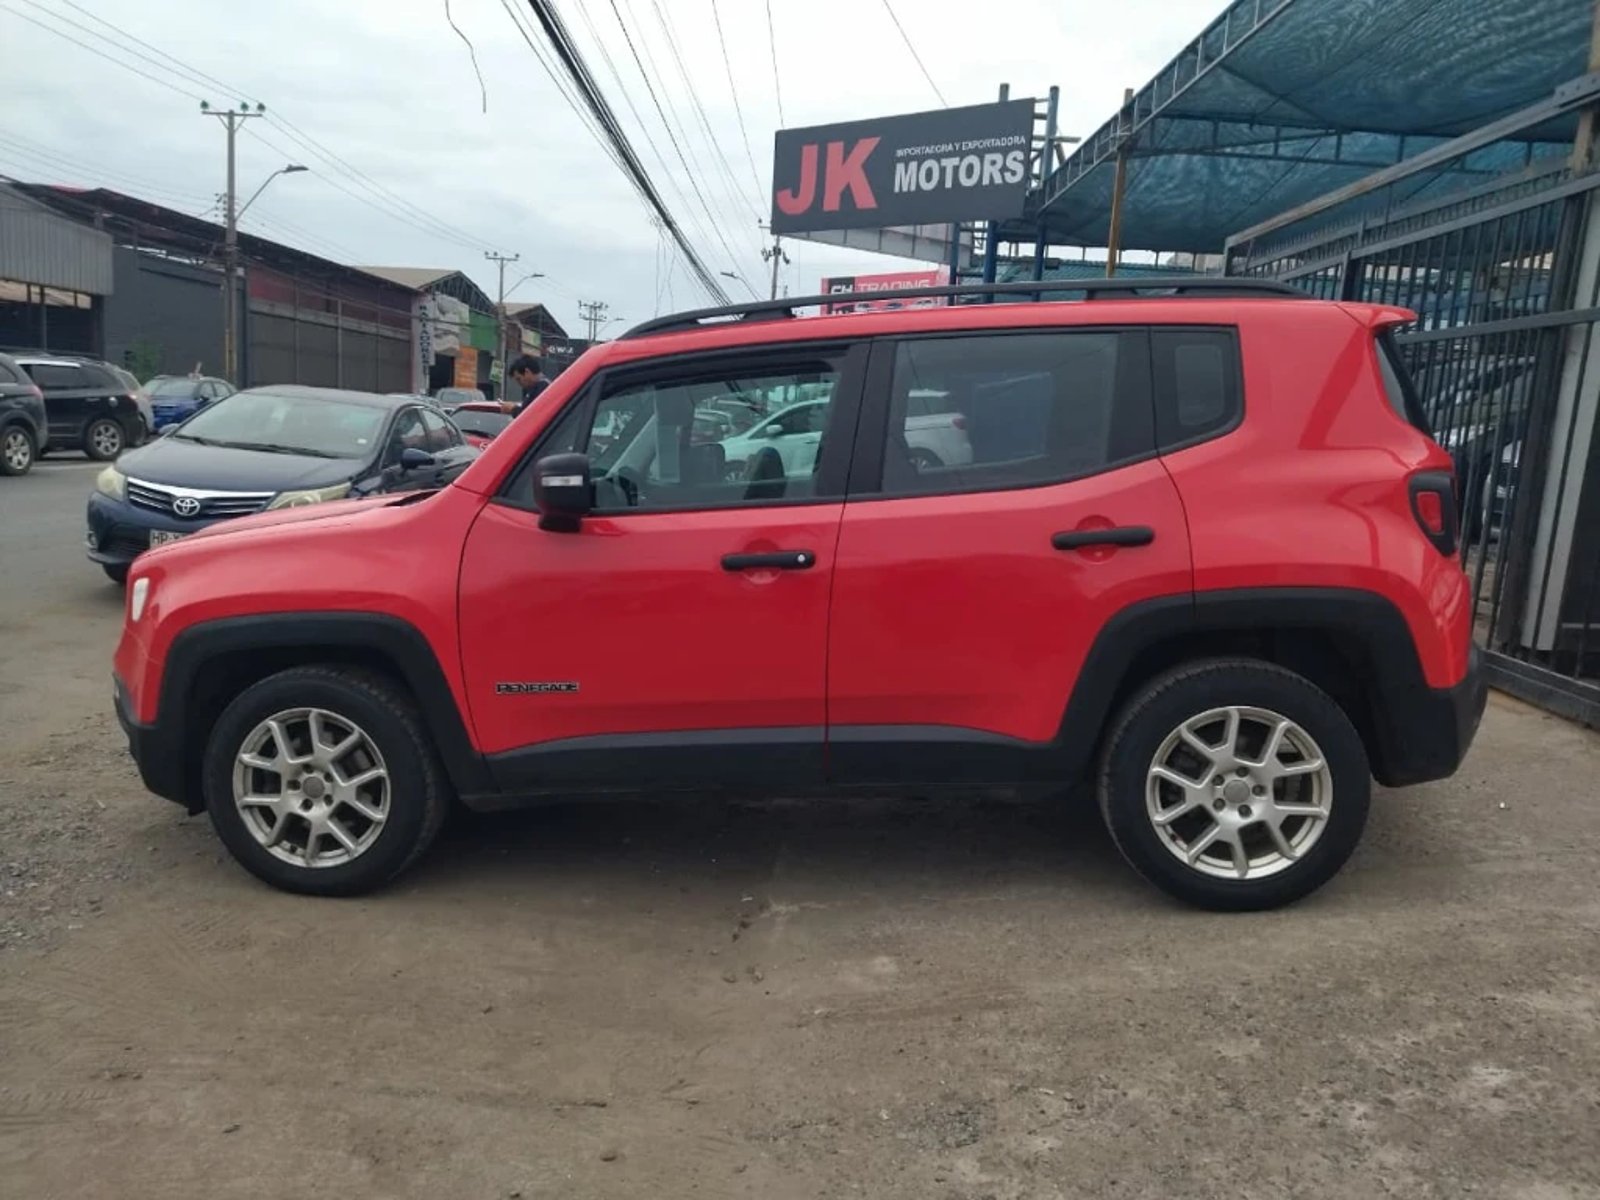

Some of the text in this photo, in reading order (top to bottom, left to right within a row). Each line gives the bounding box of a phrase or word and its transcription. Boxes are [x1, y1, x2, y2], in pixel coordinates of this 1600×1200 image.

[776, 136, 882, 215] JK
[894, 150, 1025, 193] MOTORS
[496, 681, 578, 694] RENEGADE
